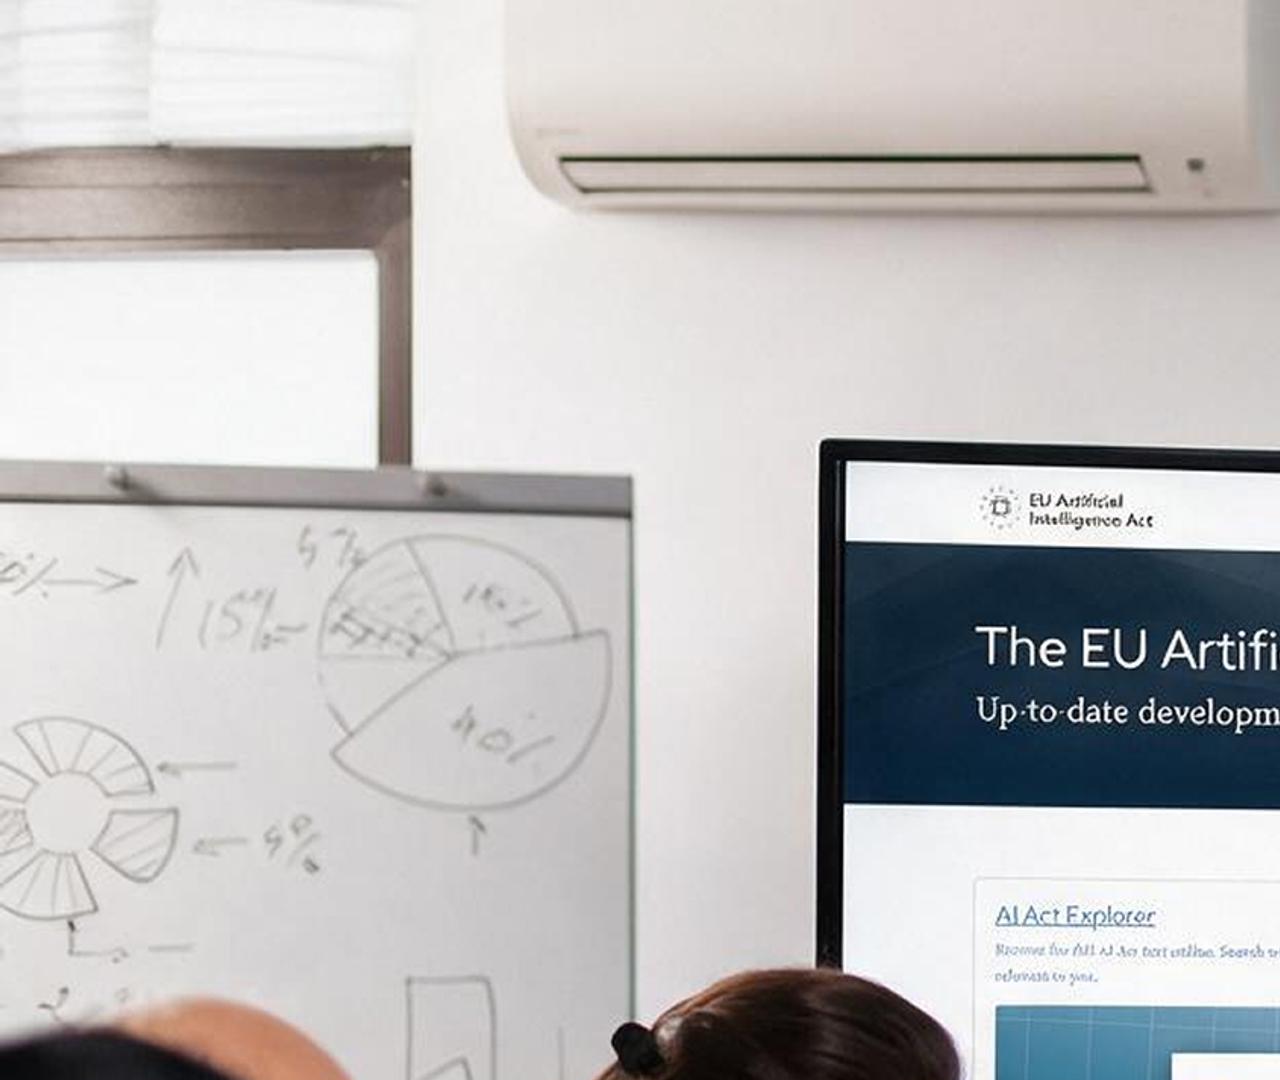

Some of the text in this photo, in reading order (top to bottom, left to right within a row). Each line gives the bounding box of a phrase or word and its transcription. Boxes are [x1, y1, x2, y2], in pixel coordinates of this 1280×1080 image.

[1029, 493, 1123, 508] EU Artificial
[1029, 512, 1153, 530] Intelligence Act
[975, 625, 1065, 669] The
[1082, 628, 1146, 670] EU
[976, 696, 1127, 729] Up-to-date
[995, 905, 1157, 931] AI Act Explorer
